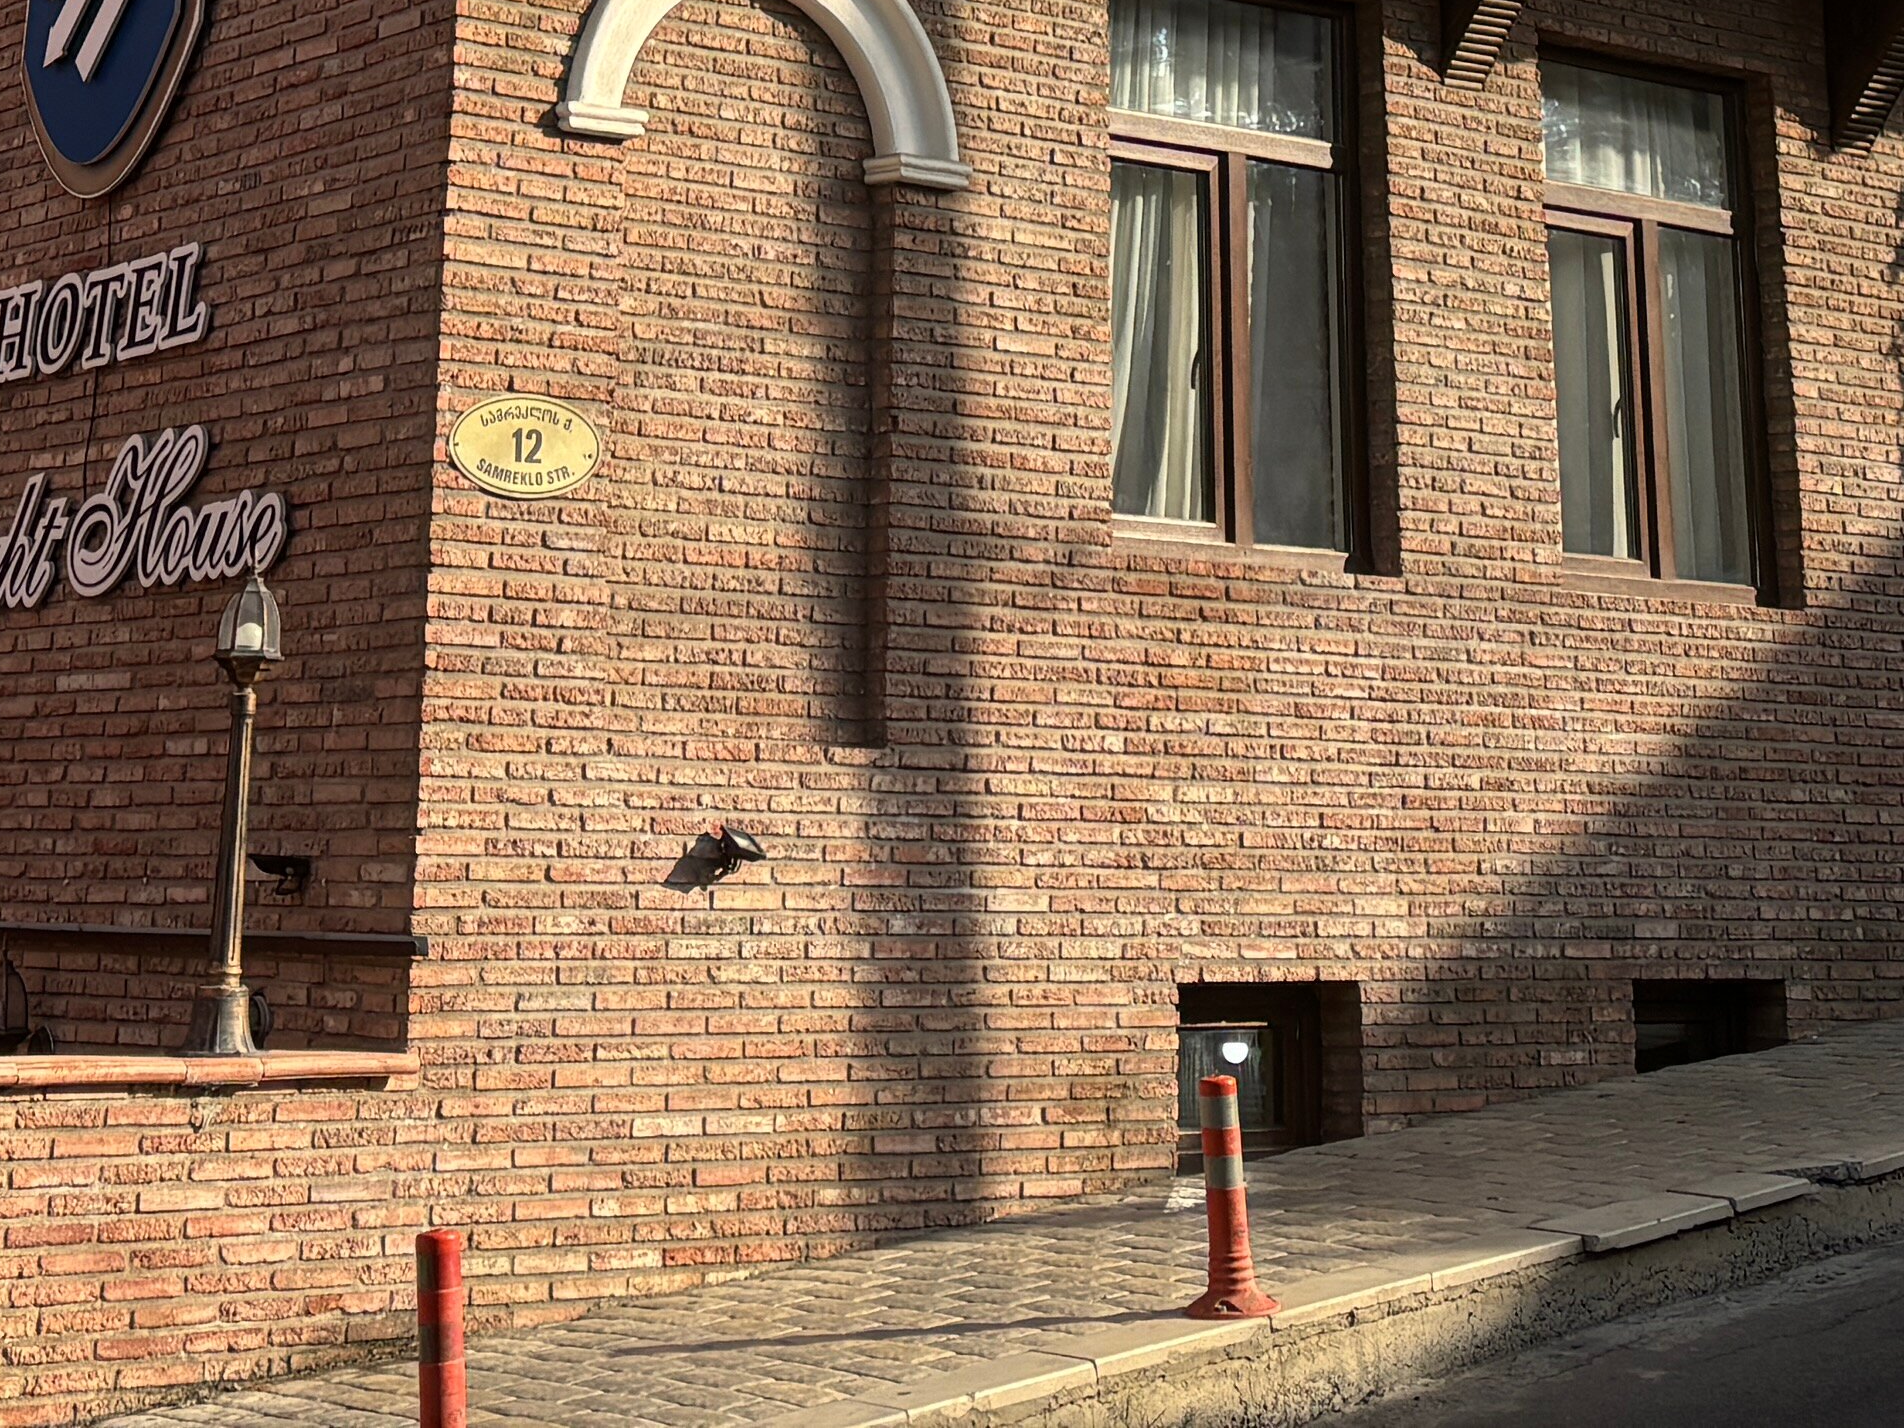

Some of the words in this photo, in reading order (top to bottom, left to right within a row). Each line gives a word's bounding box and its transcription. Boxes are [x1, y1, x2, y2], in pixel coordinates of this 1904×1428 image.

[480, 405, 560, 428] სამრეკლოს
[511, 427, 543, 464] 12
[476, 457, 543, 486] SAMREKLO
[546, 465, 576, 485] STR.
[67, 424, 288, 597] House
